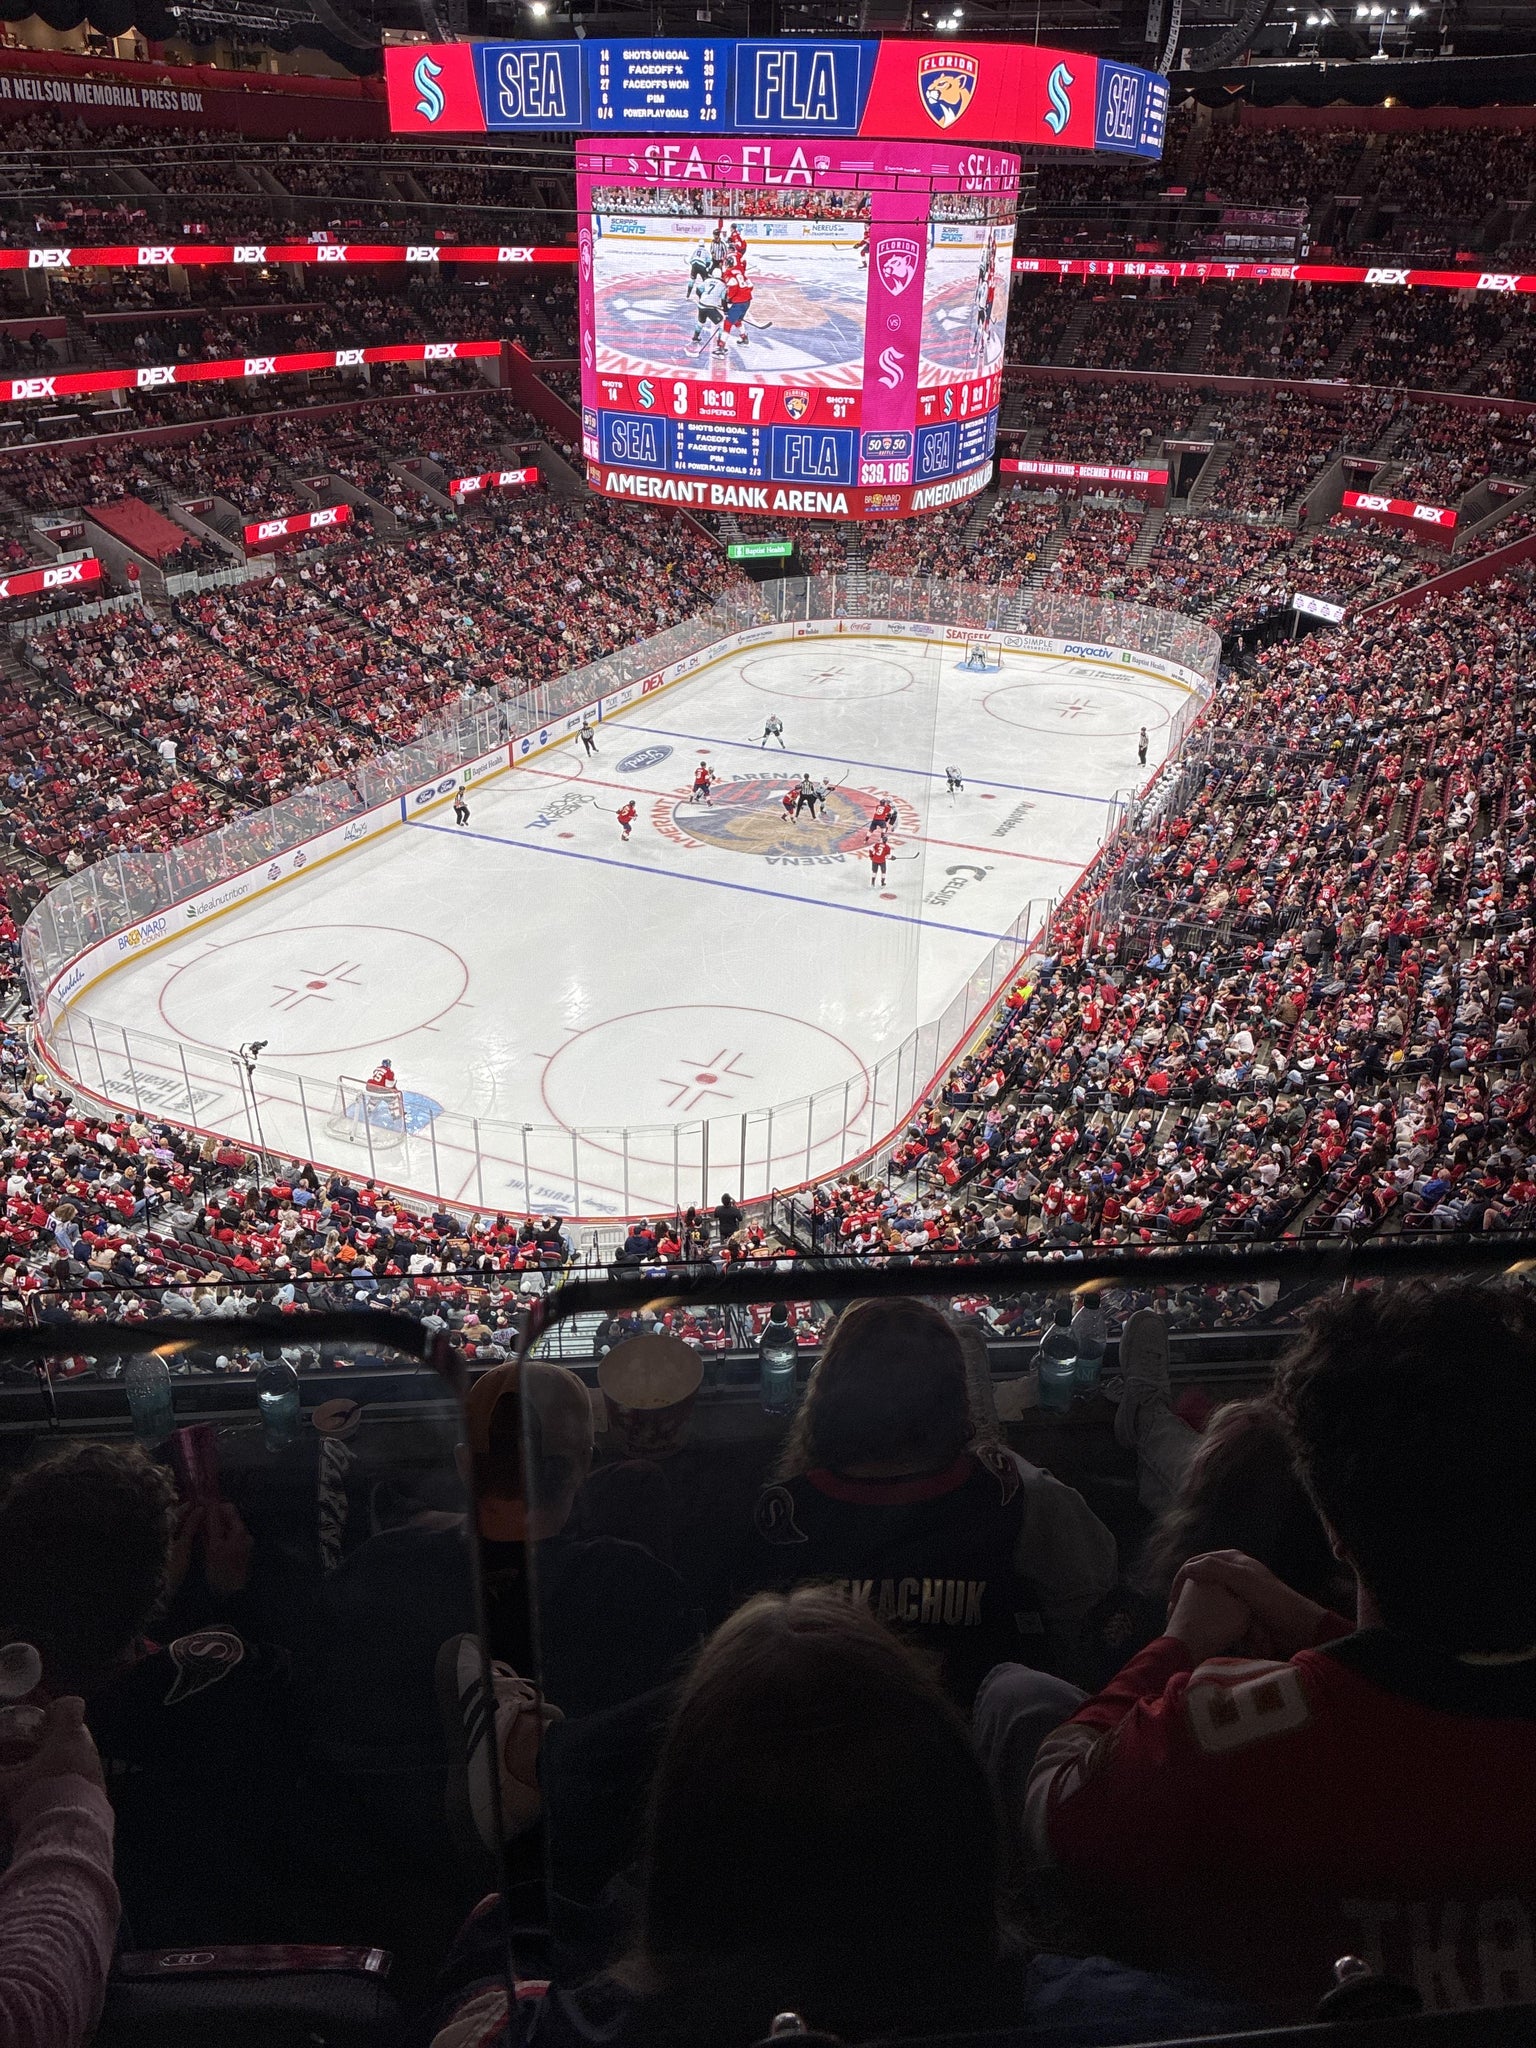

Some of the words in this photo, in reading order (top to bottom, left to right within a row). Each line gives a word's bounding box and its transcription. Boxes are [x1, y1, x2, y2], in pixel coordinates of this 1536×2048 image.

[600, 49, 609, 61] 14
[623, 50, 651, 60] SHOTS
[652, 50, 665, 60] ON
[665, 50, 689, 60] GOAL
[704, 49, 714, 61] 31
[923, 56, 974, 71] FLORIDA
[628, 65, 674, 74] FACEOFF
[675, 65, 683, 74] %
[498, 52, 566, 117] SEA
[600, 78, 609, 90] 27
[623, 80, 667, 89] FACEOFFS
[668, 80, 689, 89] WON
[704, 79, 714, 90] 17
[755, 51, 838, 120] FLA
[14, 78, 72, 103] NEILSON
[73, 83, 140, 107] MEMORIAL
[142, 89, 178, 111] PRESS
[181, 92, 203, 113] BOX
[647, 94, 664, 103] PIM
[623, 109, 646, 118] POWER
[647, 109, 665, 118] PLAY
[665, 109, 689, 118] GOALS
[700, 108, 717, 120] 2/3
[1105, 73, 1138, 139] SEA
[645, 145, 708, 182] SEA
[742, 146, 812, 184] FLA
[966, 154, 992, 190] SEA
[610, 225, 647, 234] SPORTS
[233, 246, 267, 262] DEX
[317, 246, 347, 261] DEX
[406, 247, 440, 261] DEX
[498, 248, 535, 261] DEX
[881, 240, 915, 252] FLORIDA
[28, 249, 71, 267] DEX
[138, 247, 175, 265] DEX
[1107, 262, 1113, 273] 3
[1124, 262, 1145, 274] 16:10
[1364, 268, 1411, 284] DEX
[1476, 273, 1521, 290] DEX
[335, 349, 365, 366] DEX
[424, 344, 458, 359] DEX
[244, 357, 276, 376] DEX
[137, 366, 176, 386] DEX
[602, 380, 623, 388] SHOTS
[12, 377, 56, 400] DEX
[608, 388, 618, 401] 14
[673, 382, 688, 415] 3
[702, 389, 734, 407] 16:10
[748, 387, 764, 420] 7
[826, 396, 855, 404] SHOTS
[960, 384, 968, 416] 3
[711, 408, 736, 416] PERIOD
[833, 404, 846, 418] 31
[688, 424, 714, 433] SHOTS
[716, 425, 726, 433] ON
[727, 425, 747, 435] GOAL
[612, 420, 656, 461] SEA
[696, 435, 730, 443] FACEOFF
[868, 439, 881, 450] 50
[892, 439, 906, 449] 50
[688, 444, 728, 453] FACEOFFS
[729, 446, 747, 455] WON
[785, 435, 838, 476] FLA
[923, 431, 950, 473] SEA
[688, 463, 709, 471] POWER
[710, 465, 725, 473] PLAY
[726, 466, 746, 474] GOALS
[861, 462, 909, 485] $39,105
[1018, 461, 1038, 472] WORLD
[1038, 463, 1053, 473] TEAM
[1055, 464, 1074, 475] TENNIS
[1079, 466, 1109, 478] DECEMBER
[1133, 470, 1148, 481] 15TH
[459, 477, 482, 492] DEX
[500, 471, 526, 484] DEX
[605, 472, 707, 502] AMERANT
[711, 484, 771, 508] BANK
[772, 489, 849, 514] ARENA
[911, 477, 968, 511] AMERANT
[1356, 495, 1393, 512] DEX
[310, 509, 337, 527] DEX
[1413, 505, 1444, 523] DEX
[258, 520, 287, 539] DEX
[745, 546, 764, 556] Baptist
[766, 546, 785, 554] Health
[43, 564, 83, 588] DEX
[1023, 638, 1052, 648] SIMPLE
[1064, 643, 1113, 660] payactiv
[1132, 654, 1149, 669] Baptist
[1150, 661, 1166, 672] Health
[642, 672, 665, 695] DEX
[472, 763, 488, 776] Baptist
[488, 756, 503, 769] Health
[624, 748, 665, 769] Ford
[765, 854, 846, 866] ARENA
[197, 883, 249, 915] idealnutrition
[142, 929, 167, 946] COUNTY
[302, 1219, 316, 1230] 21
[838, 1577, 986, 1625] KACHUK
